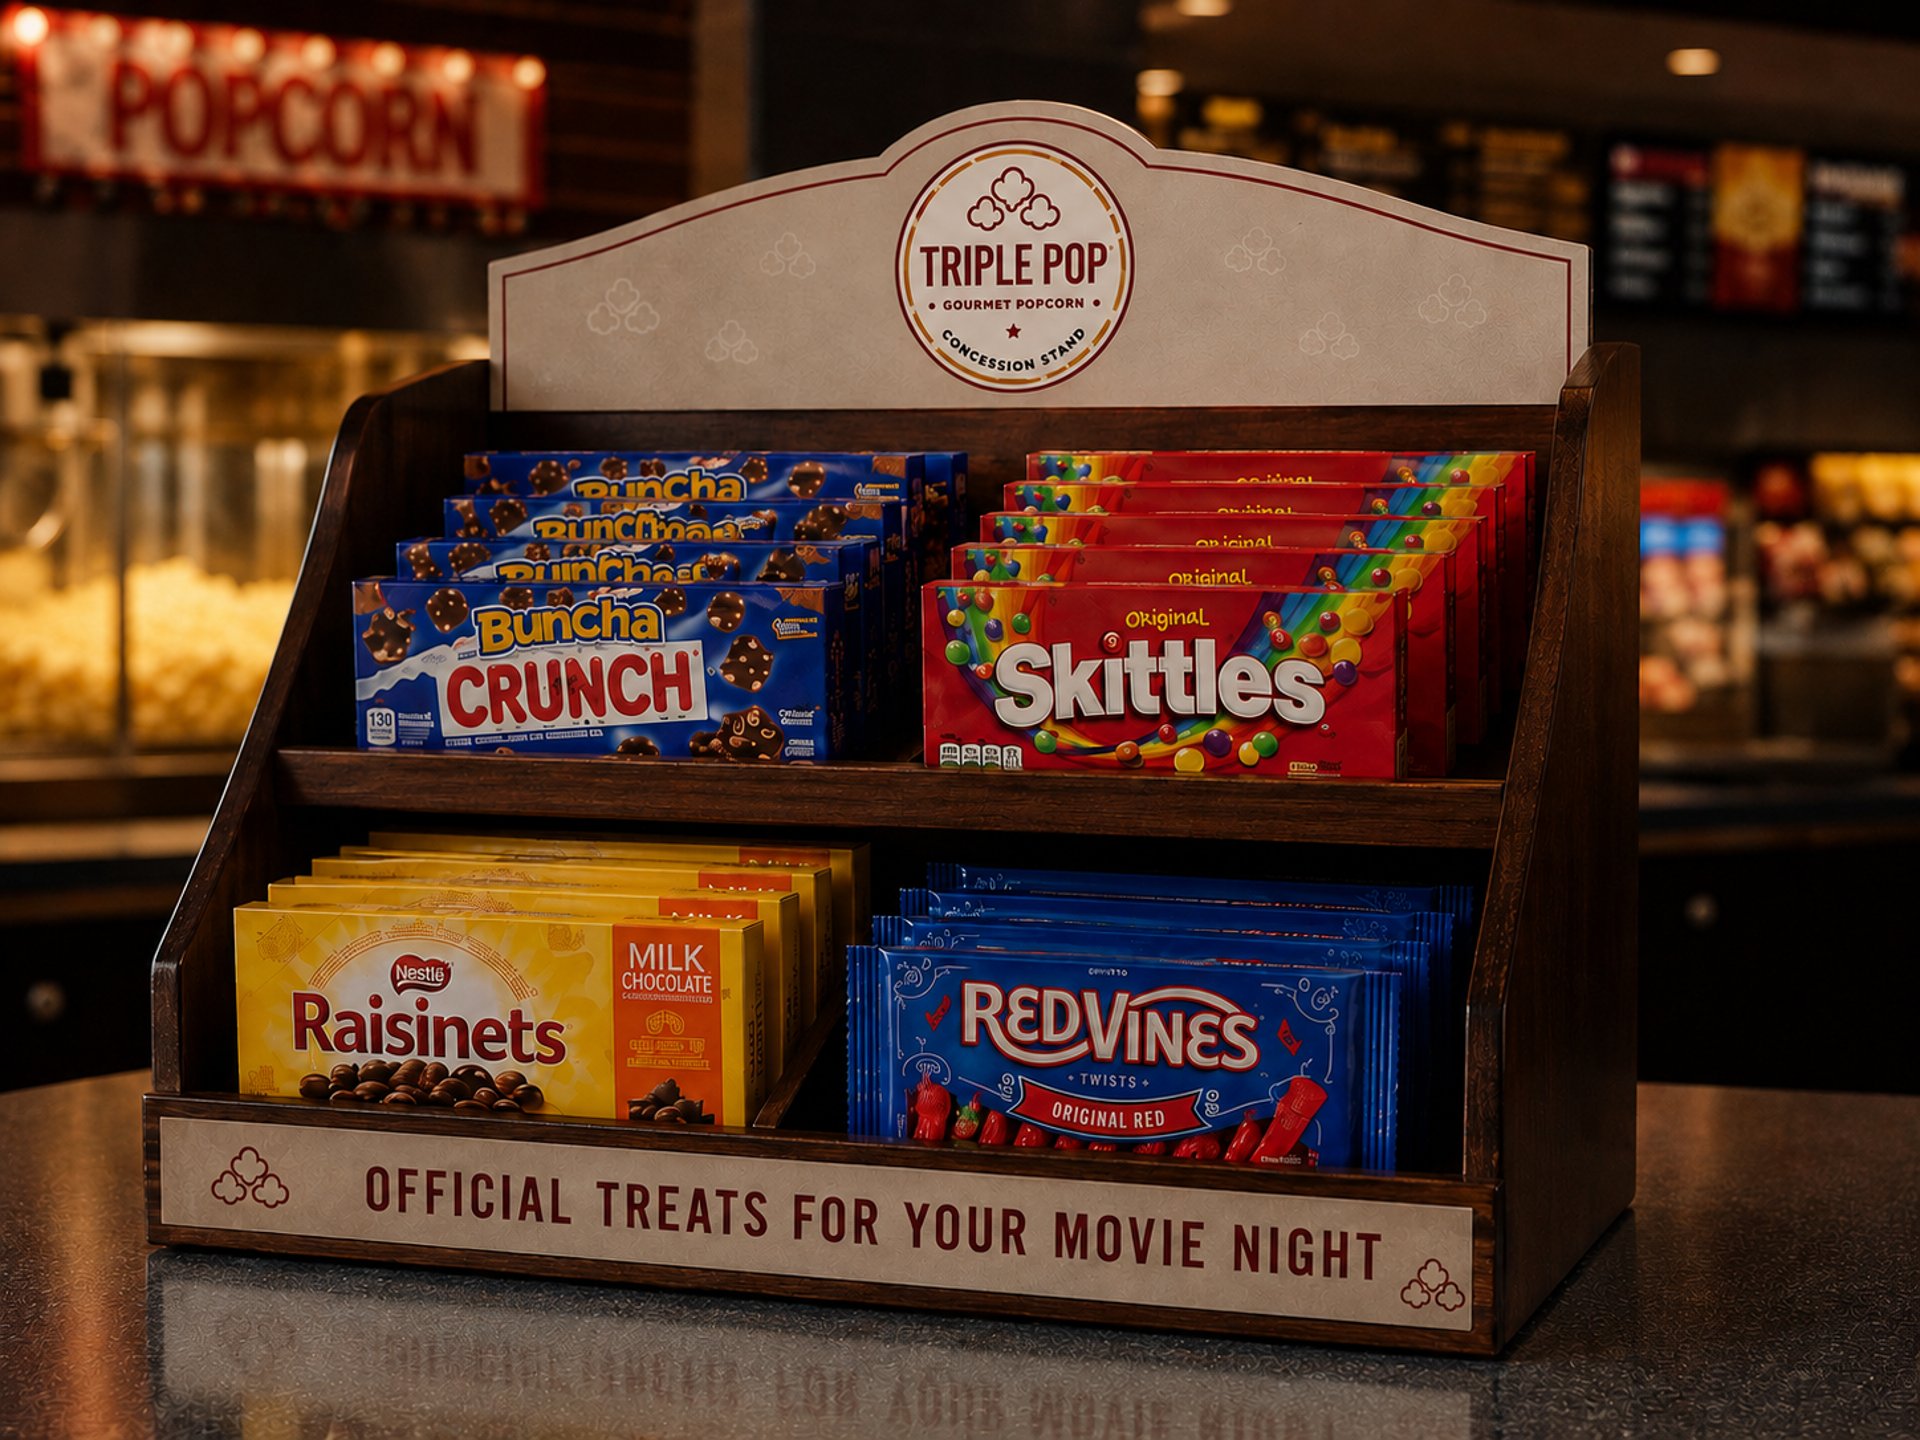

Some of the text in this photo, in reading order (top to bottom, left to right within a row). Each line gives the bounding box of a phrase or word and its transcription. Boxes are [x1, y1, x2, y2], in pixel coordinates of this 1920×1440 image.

[109, 60, 480, 175] POPCORN
[920, 242, 1108, 287] TRIPLE POP
[943, 298, 1084, 310] GOURMET POPCORN
[942, 328, 1085, 371] CONCESSION STAND
[476, 597, 662, 654] Buncha
[447, 650, 693, 728] CRUNCH
[994, 632, 1326, 728] Skittles
[369, 712, 392, 727] 130
[629, 943, 705, 972] MILK
[621, 971, 713, 994] CHOCOLATE
[292, 992, 566, 1064] Raisinets
[1080, 1072, 1137, 1089] TWISTS
[1052, 1101, 1166, 1129] ORIGINAL RED
[366, 1166, 1382, 1280] OFFICIAL TREATS FOR YOUR MOVIE NIGHT
